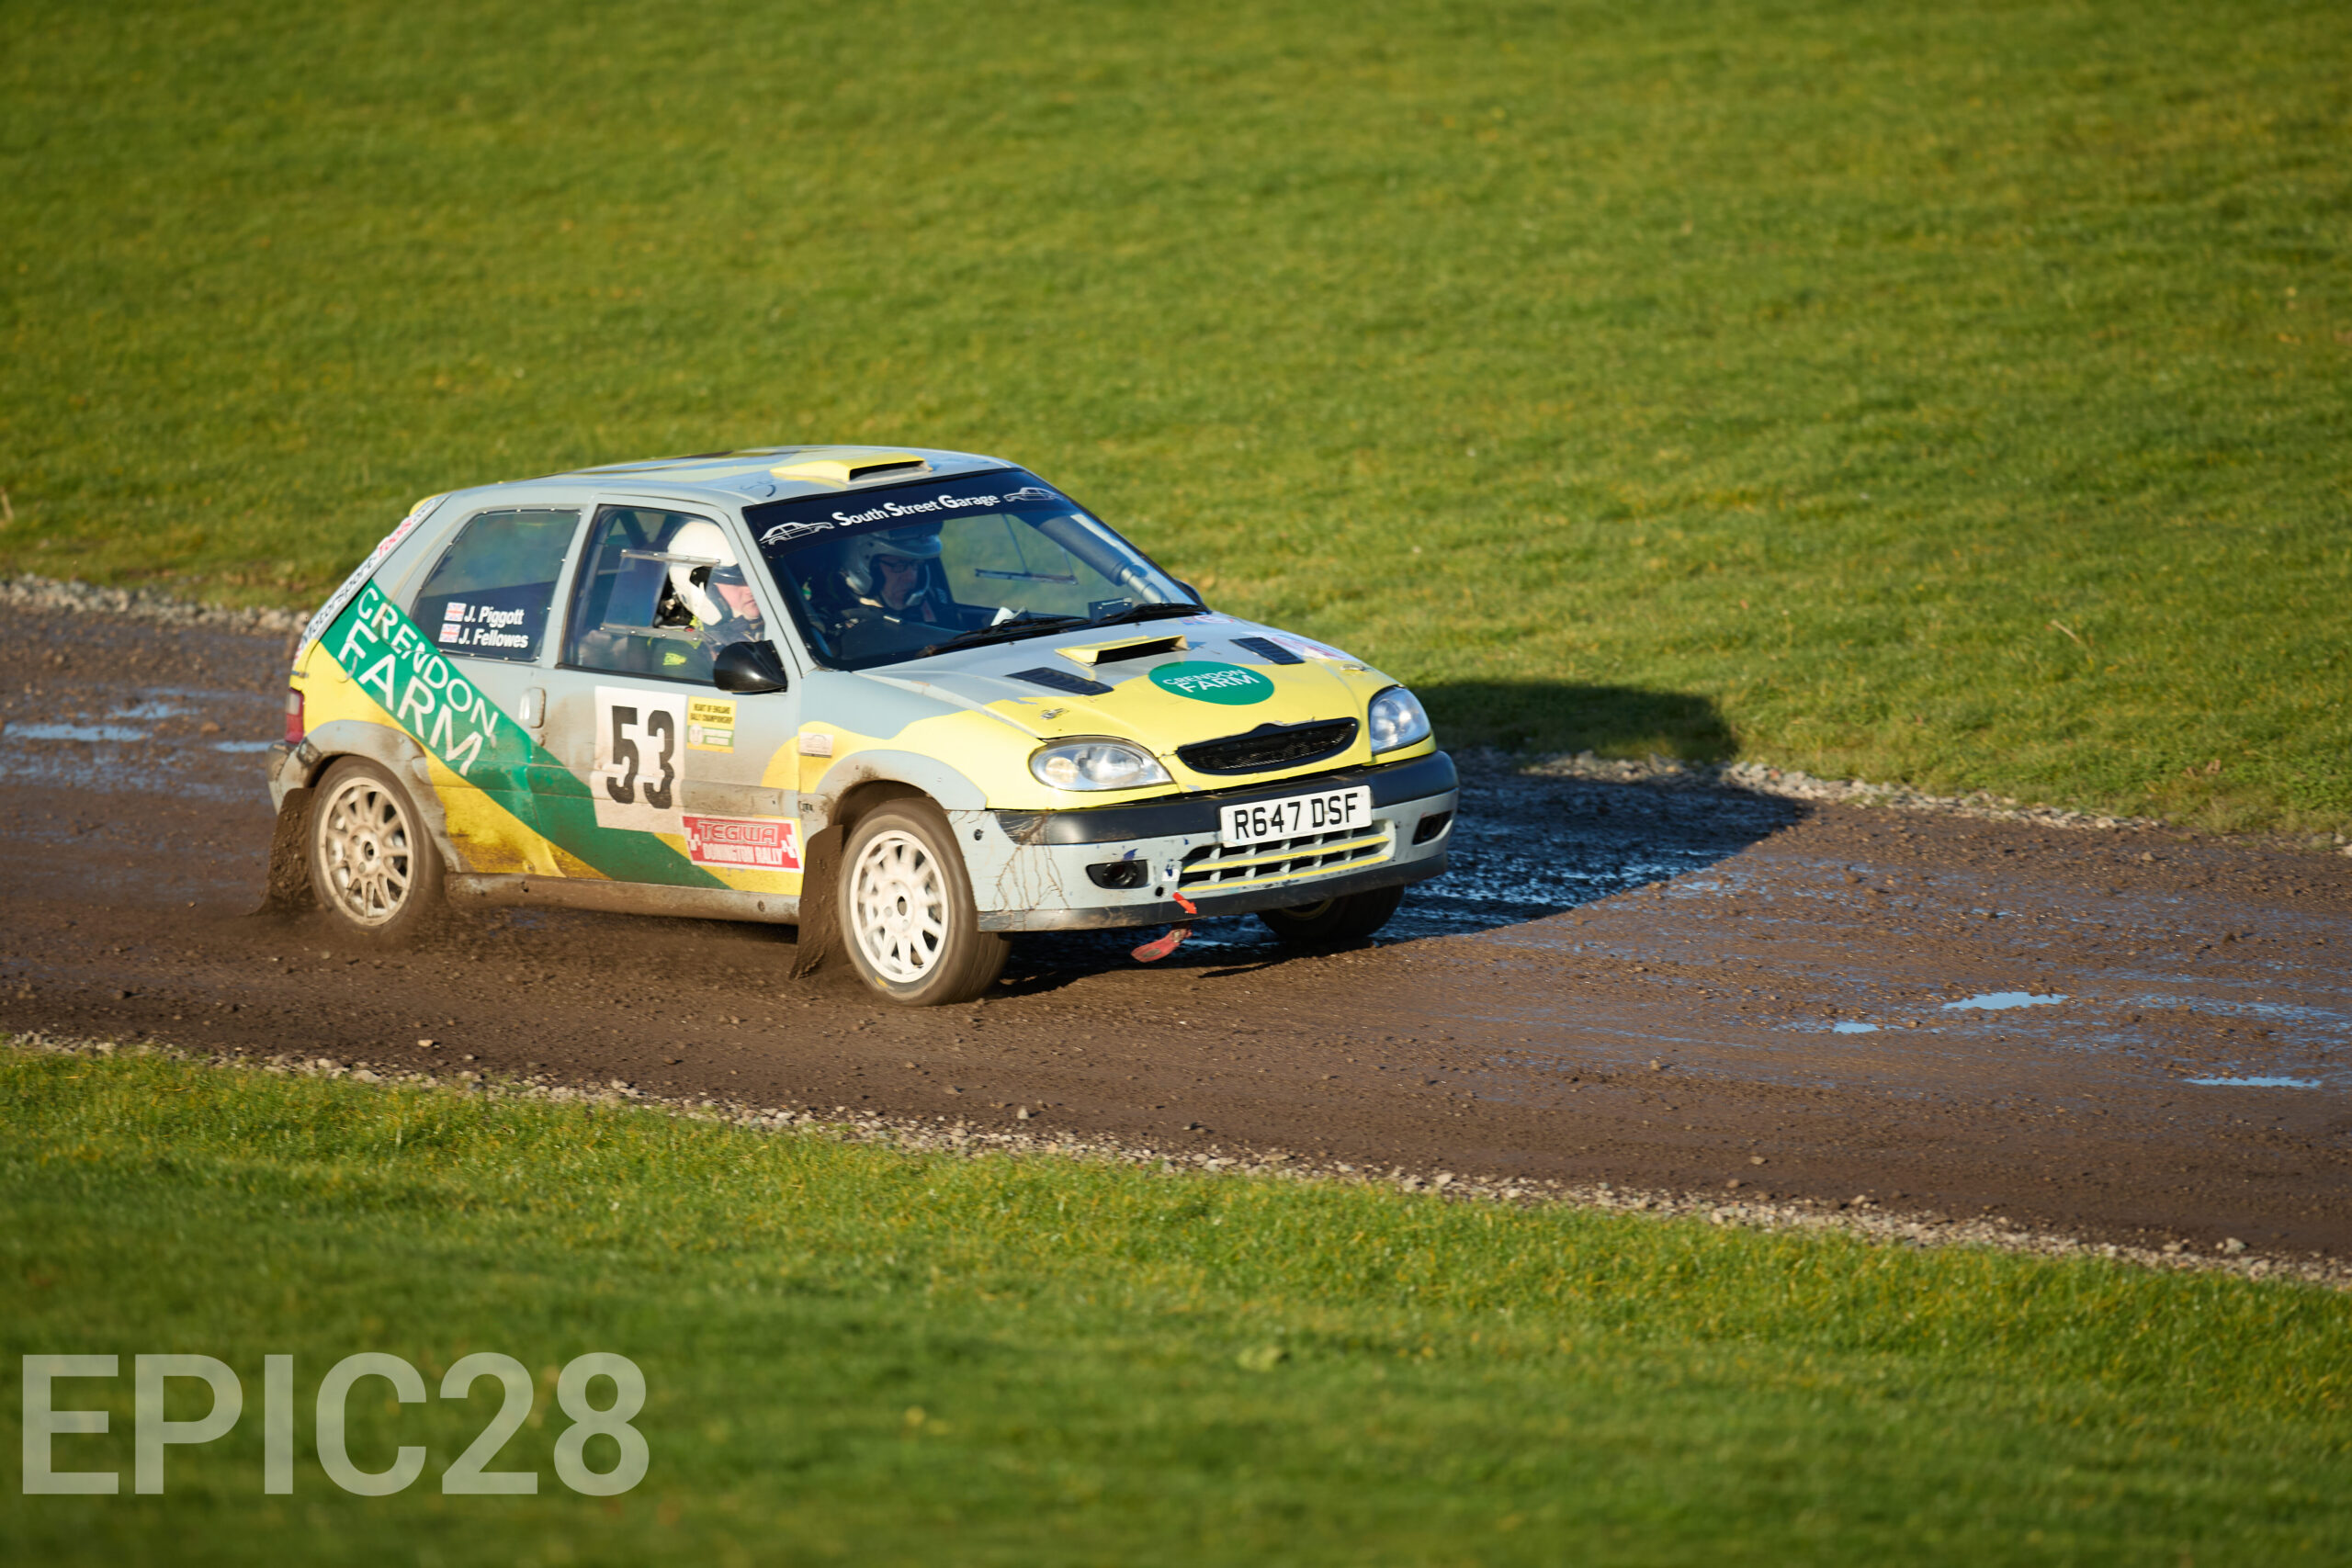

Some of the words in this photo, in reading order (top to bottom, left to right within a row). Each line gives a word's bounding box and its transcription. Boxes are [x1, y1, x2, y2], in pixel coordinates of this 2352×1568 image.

[831, 509, 889, 526] South
[883, 501, 943, 517] Street
[938, 494, 1001, 509] Garage
[464, 605, 477, 623] J.
[478, 606, 526, 628] Piggott
[458, 627, 470, 645] J.
[472, 628, 529, 649] Fellowes
[357, 588, 499, 749] GRENDON
[1162, 670, 1247, 685] GRENDON
[337, 618, 484, 776] FARM
[1176, 674, 1261, 693] FARM
[606, 705, 675, 809] 53
[1234, 801, 1301, 840] R647
[1310, 793, 1358, 829] DSF
[697, 820, 778, 847] TEGIWA
